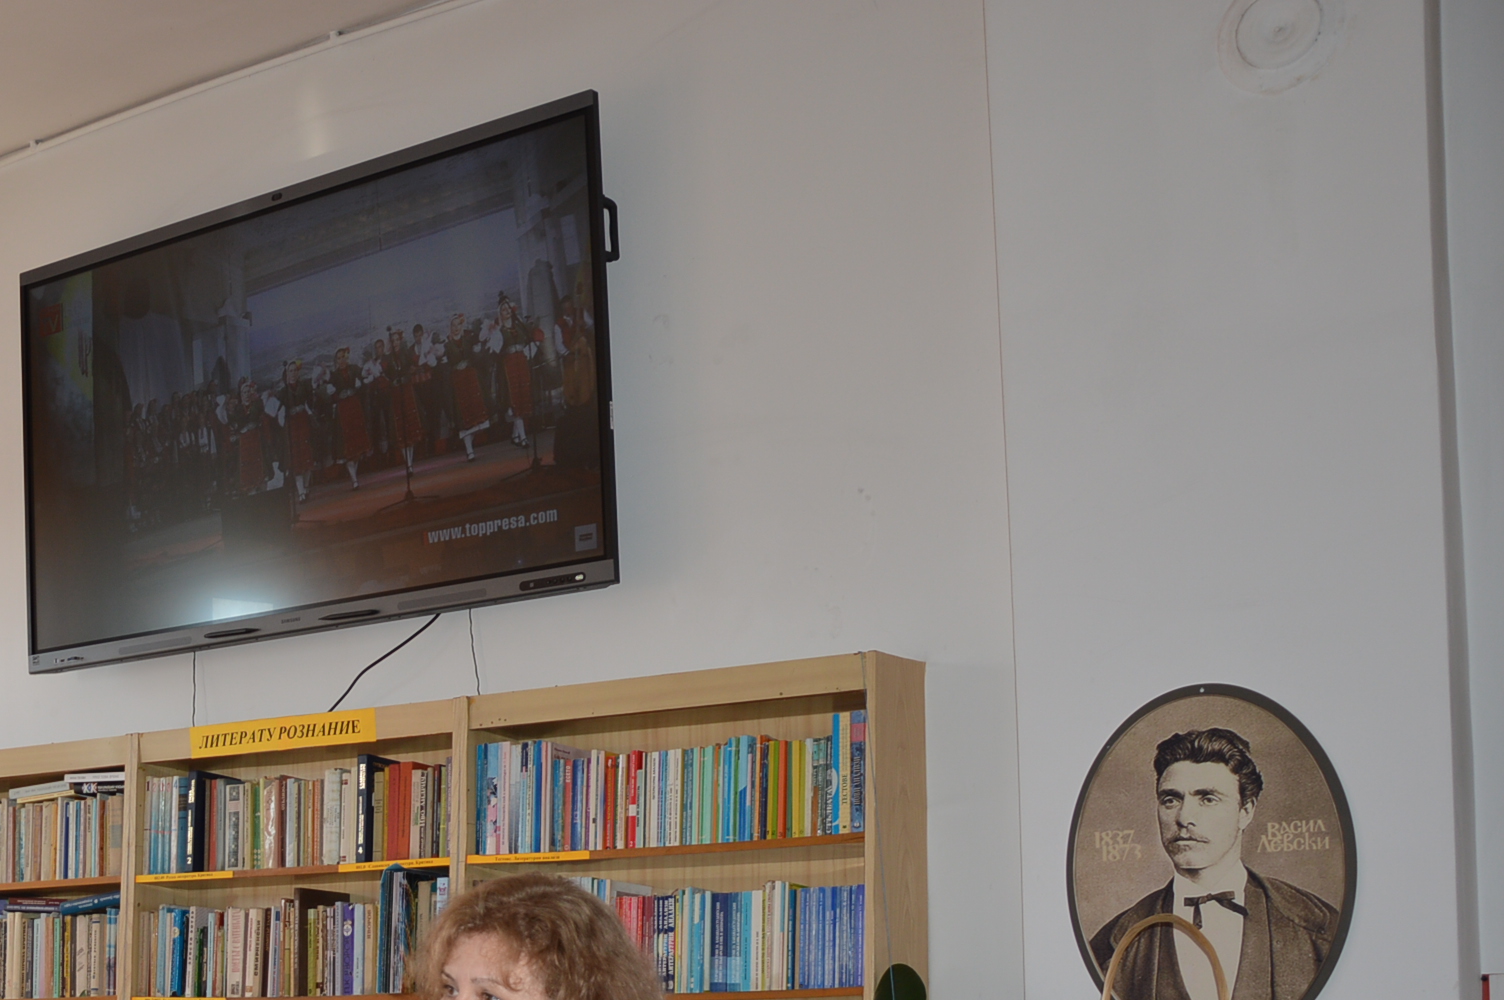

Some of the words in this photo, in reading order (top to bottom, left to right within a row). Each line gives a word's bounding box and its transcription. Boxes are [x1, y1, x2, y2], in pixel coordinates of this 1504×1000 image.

[427, 508, 558, 544] www.toppresa.com
[198, 719, 361, 749] ЛИТЕРАТУРОЗНАНИЕ
[1094, 829, 1135, 849] 1837
[1267, 819, 1326, 840] ВАСИЛ
[1101, 843, 1143, 863] 1873
